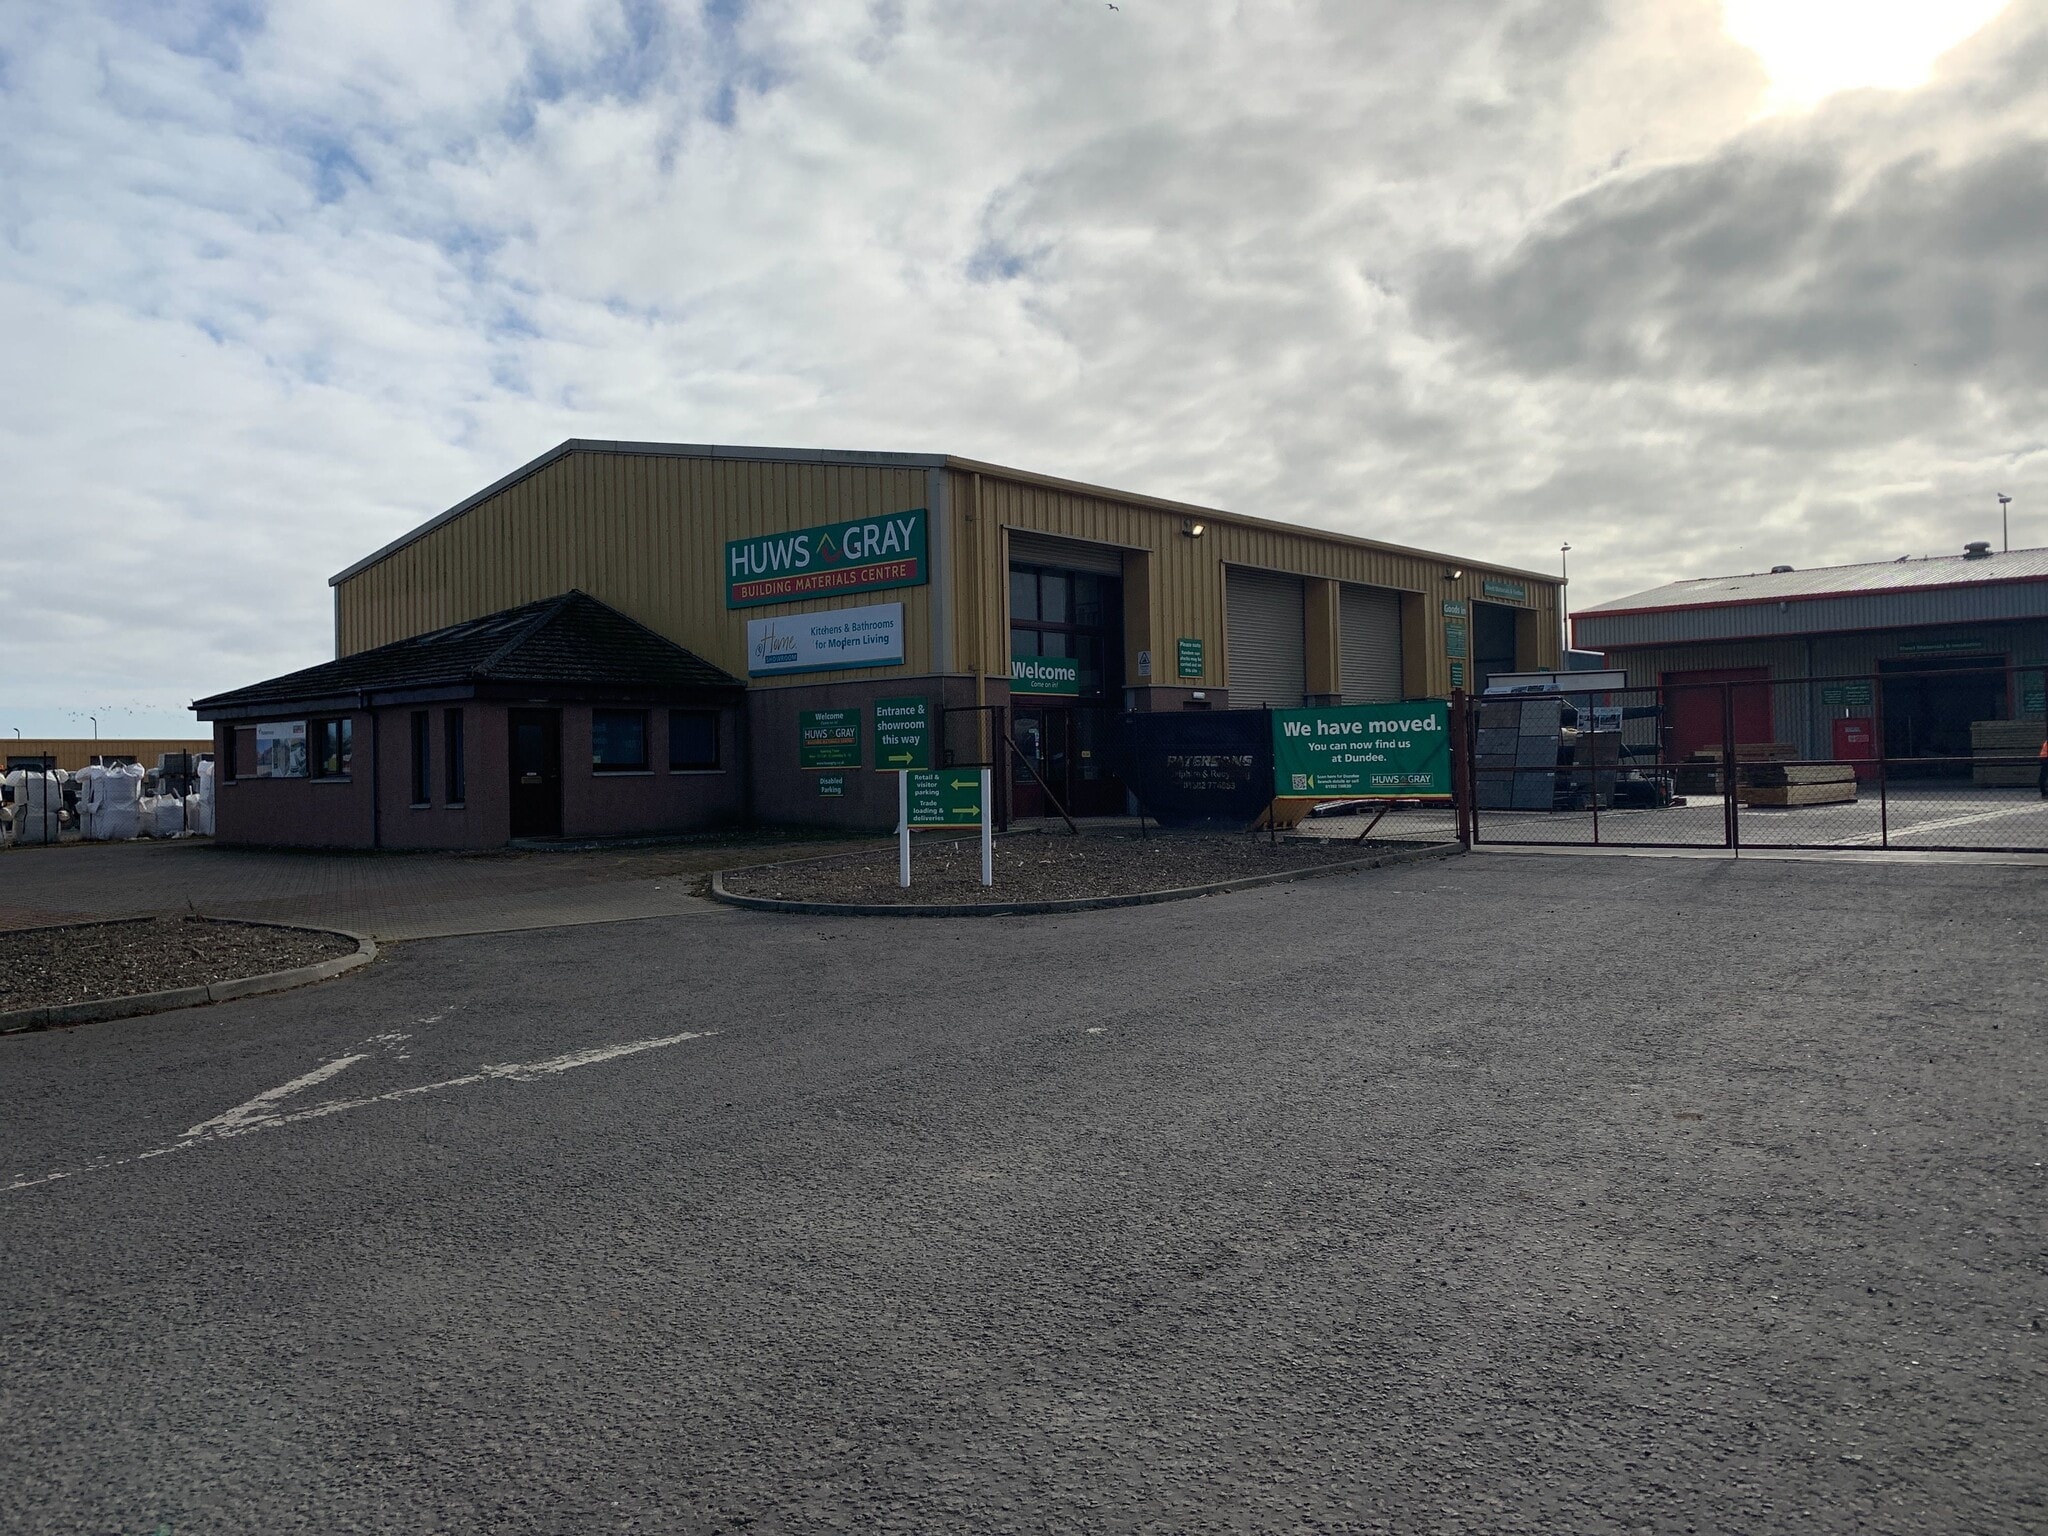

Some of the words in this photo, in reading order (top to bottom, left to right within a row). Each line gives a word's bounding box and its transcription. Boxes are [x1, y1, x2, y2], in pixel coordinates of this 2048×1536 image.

[731, 536, 810, 577] HUWS
[843, 517, 916, 560] GRAY
[741, 581, 791, 598] BUILDING
[795, 571, 857, 590] MATERIALS
[861, 564, 907, 582] CENTRE
[1444, 604, 1460, 613] Goods
[810, 625, 842, 636] Kitchens
[844, 624, 850, 633] &
[852, 620, 894, 632] Bathrooms
[815, 639, 826, 649] for
[828, 637, 861, 650] Modern
[863, 634, 889, 645] Living
[1011, 661, 1076, 681] Welcome
[876, 706, 915, 717] Entrance
[917, 704, 925, 714] &
[815, 712, 844, 721] Welcome
[877, 720, 925, 731] showroom
[1283, 721, 1312, 737] We
[1317, 718, 1362, 735] have
[1369, 714, 1442, 733] moved.
[804, 728, 828, 739] HUWS
[835, 728, 855, 738] GRAY
[882, 734, 898, 745] this
[901, 734, 920, 746] way
[1308, 742, 1328, 751] You
[1330, 742, 1347, 750] can
[1350, 741, 1373, 750] now
[1375, 739, 1396, 749] find
[1398, 740, 1411, 748] us
[1332, 754, 1342, 763] at
[1344, 752, 1387, 762] Dundee.
[1372, 775, 1399, 785] HUWS
[1407, 774, 1431, 784] GRAY
[821, 786, 842, 794] Parking
[914, 788, 940, 796] parking
[913, 807, 937, 815] loading
